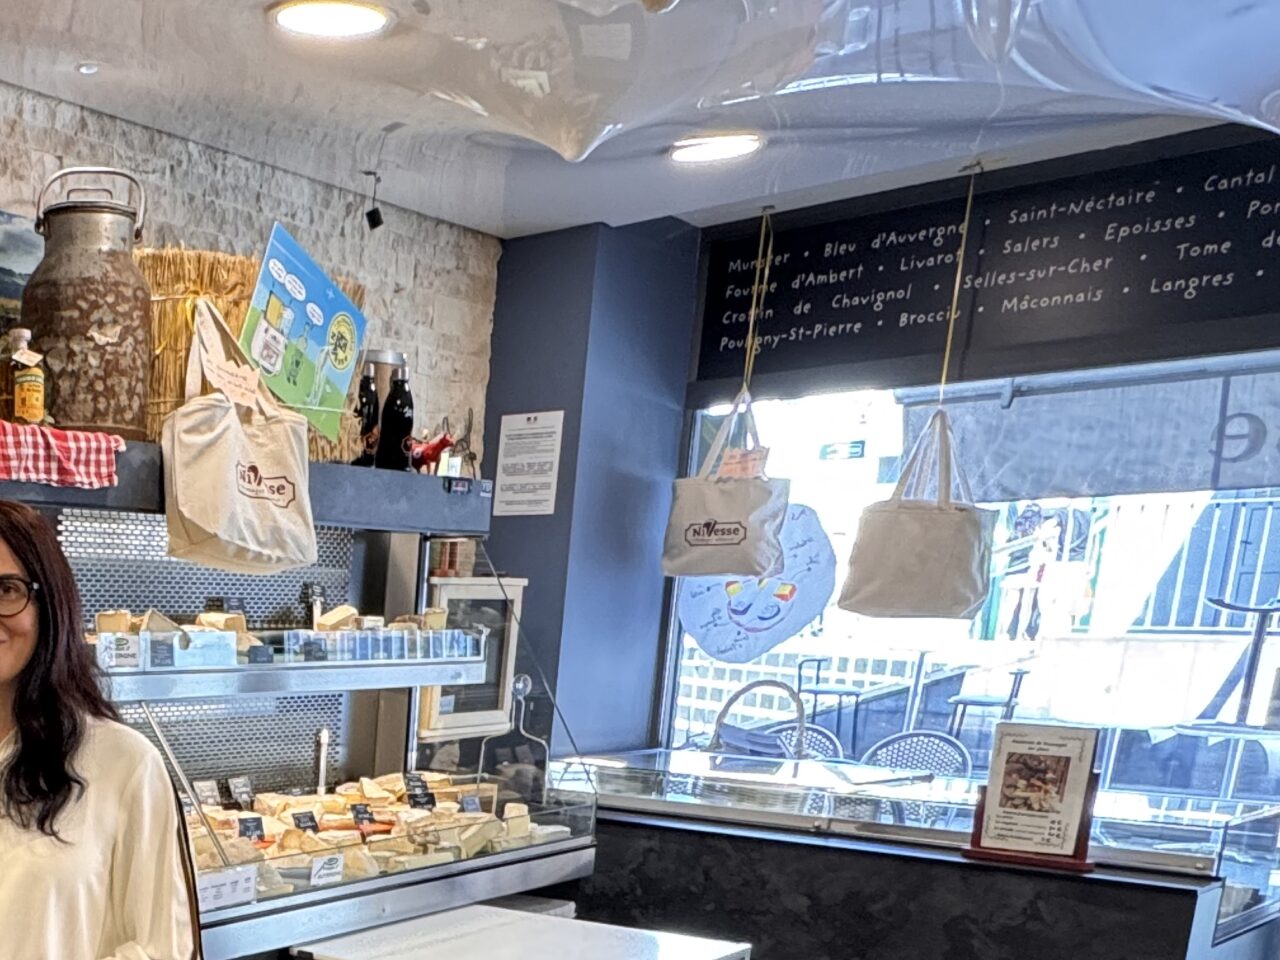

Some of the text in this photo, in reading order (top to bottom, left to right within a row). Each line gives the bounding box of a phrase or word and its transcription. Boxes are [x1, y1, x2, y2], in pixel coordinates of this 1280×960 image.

[823, 241, 857, 258] Bleu
[1204, 164, 1276, 192] Cantal
[791, 263, 864, 290] d'Ambert
[1002, 236, 1060, 254] Salers
[1105, 215, 1197, 243] Epoisses
[793, 300, 812, 315] de
[831, 283, 913, 312] Chavignol
[963, 256, 1114, 289] Selles-sur-Cher
[1176, 241, 1232, 260] Tome
[719, 321, 862, 355] Poulgny-St-Pierre
[1001, 285, 1104, 313] Mâconnais
[1150, 272, 1235, 299] Langres
